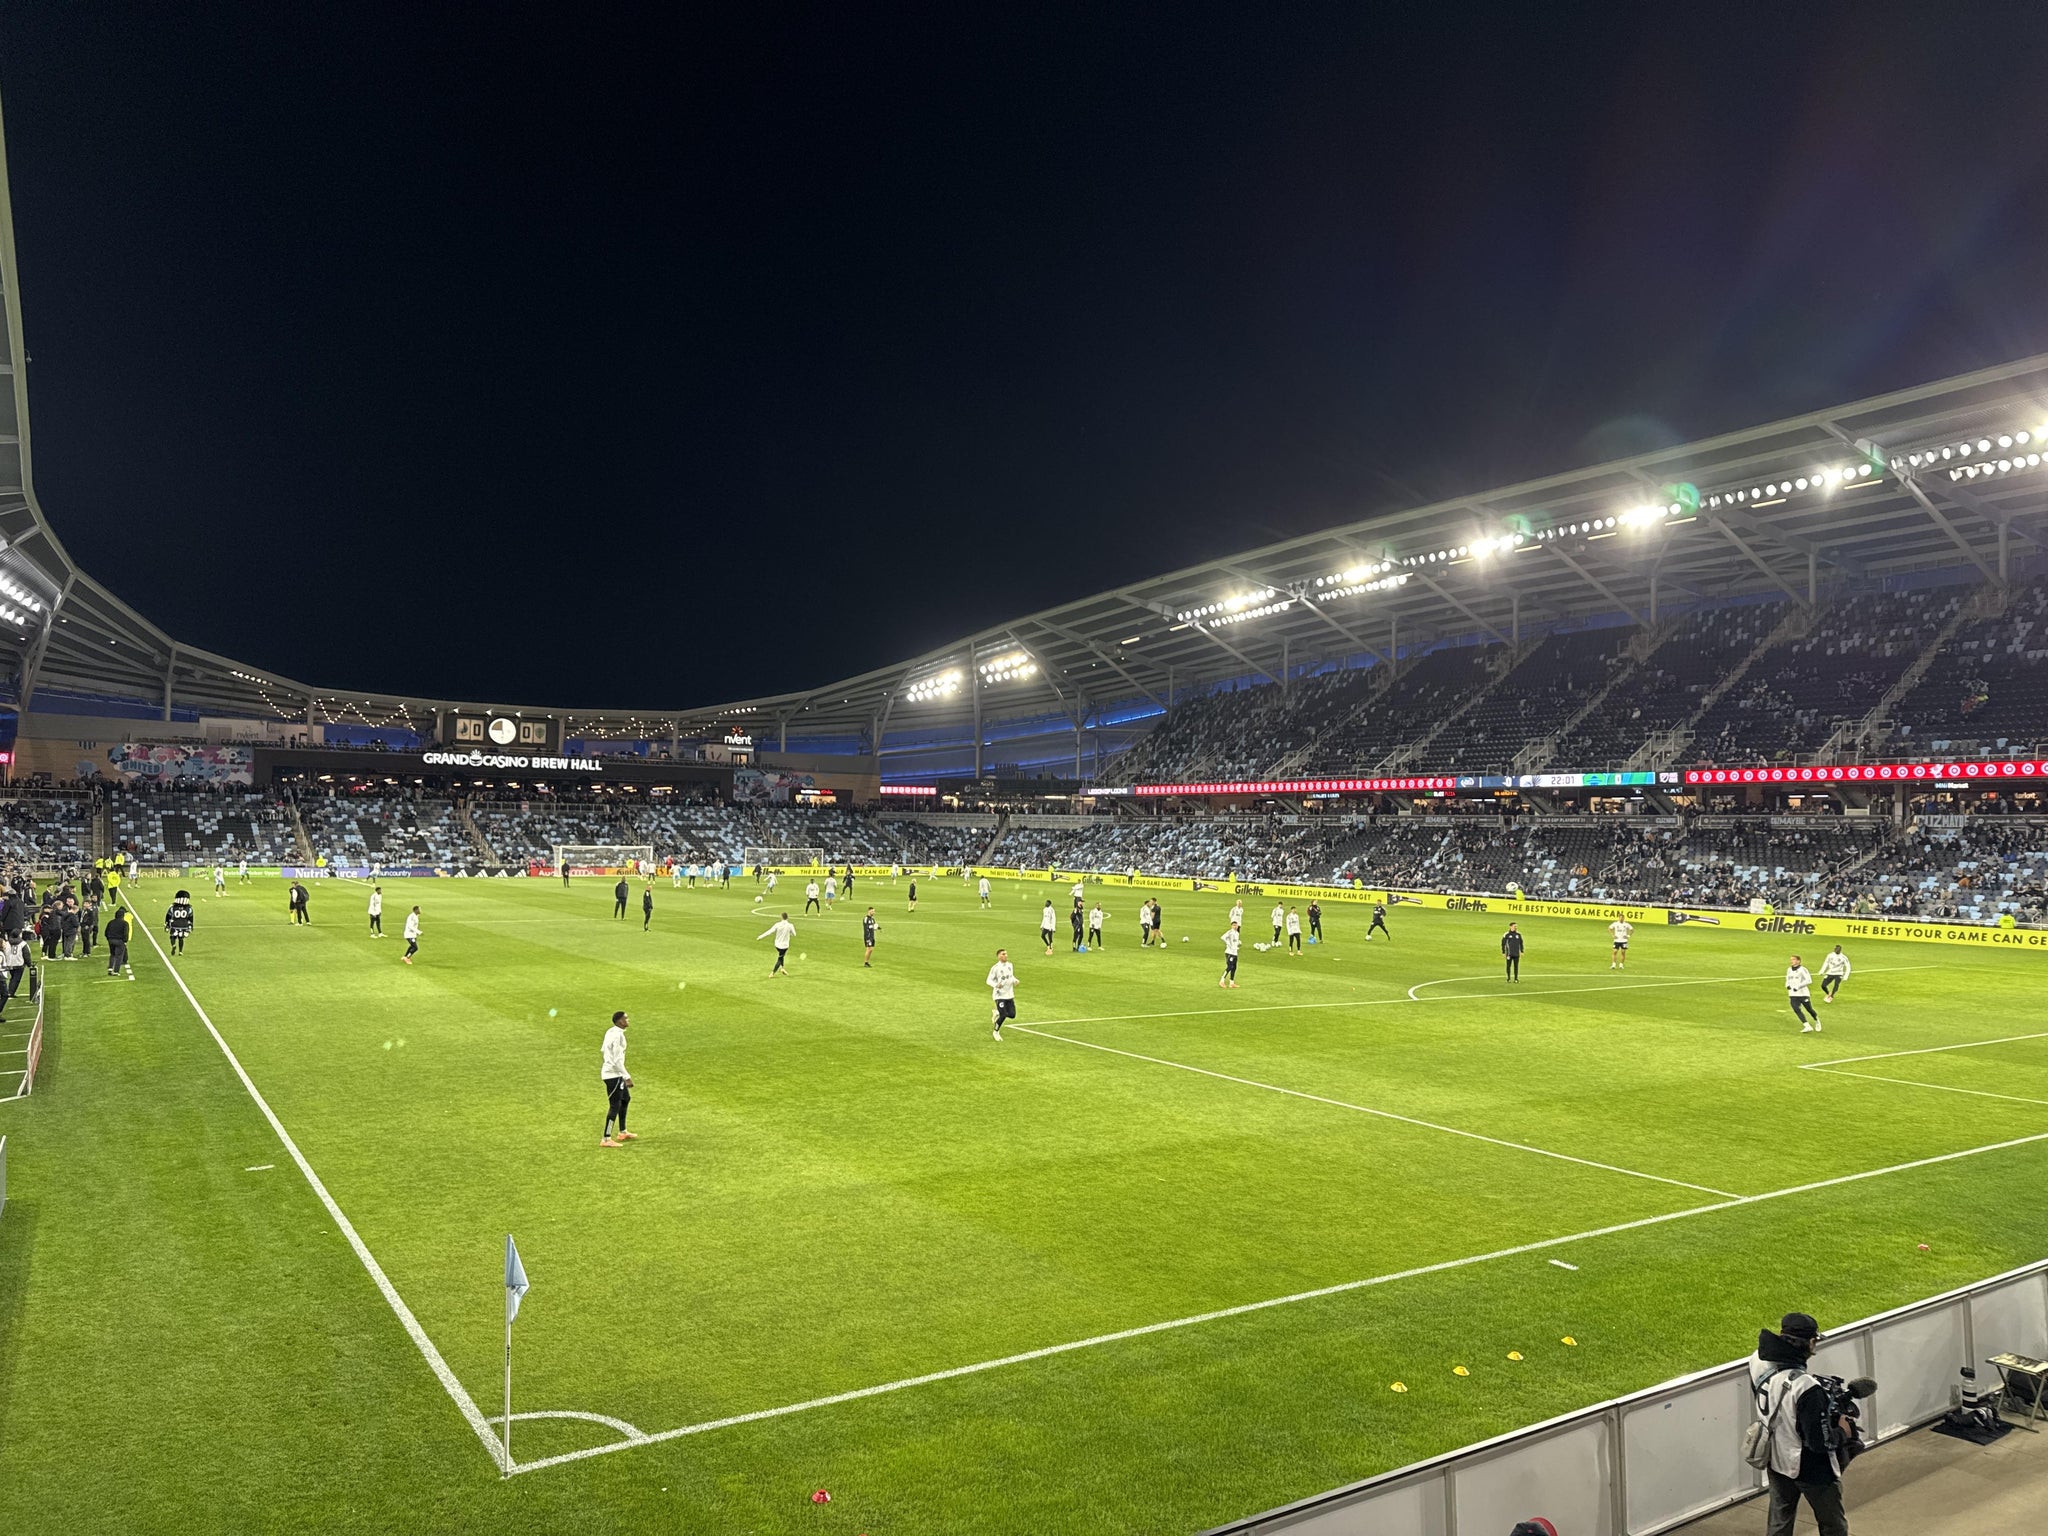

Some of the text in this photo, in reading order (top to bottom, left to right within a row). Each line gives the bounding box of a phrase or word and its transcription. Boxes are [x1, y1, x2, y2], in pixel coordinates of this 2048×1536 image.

[423, 752, 602, 770] GRAND CASINO BREW HALL
[1551, 776, 1574, 784] 22:01
[295, 868, 358, 878] NutriSurce
[946, 868, 978, 877] Gille
[1235, 884, 1264, 896] Gillette
[1446, 898, 1488, 912] Gillette
[1525, 904, 1544, 913] BEST
[1547, 906, 1571, 915] YOUR
[1574, 908, 1600, 916] GAME
[1604, 910, 1624, 918] CAN
[1627, 911, 1644, 919] GET
[174, 910, 187, 918] 00
[1754, 917, 1816, 935] Gillette
[1846, 924, 1868, 934] THE
[1872, 926, 1901, 936] BEST
[1905, 928, 1942, 939] YOUR
[1947, 930, 1988, 942] GAME
[1992, 933, 2023, 944] CAN
